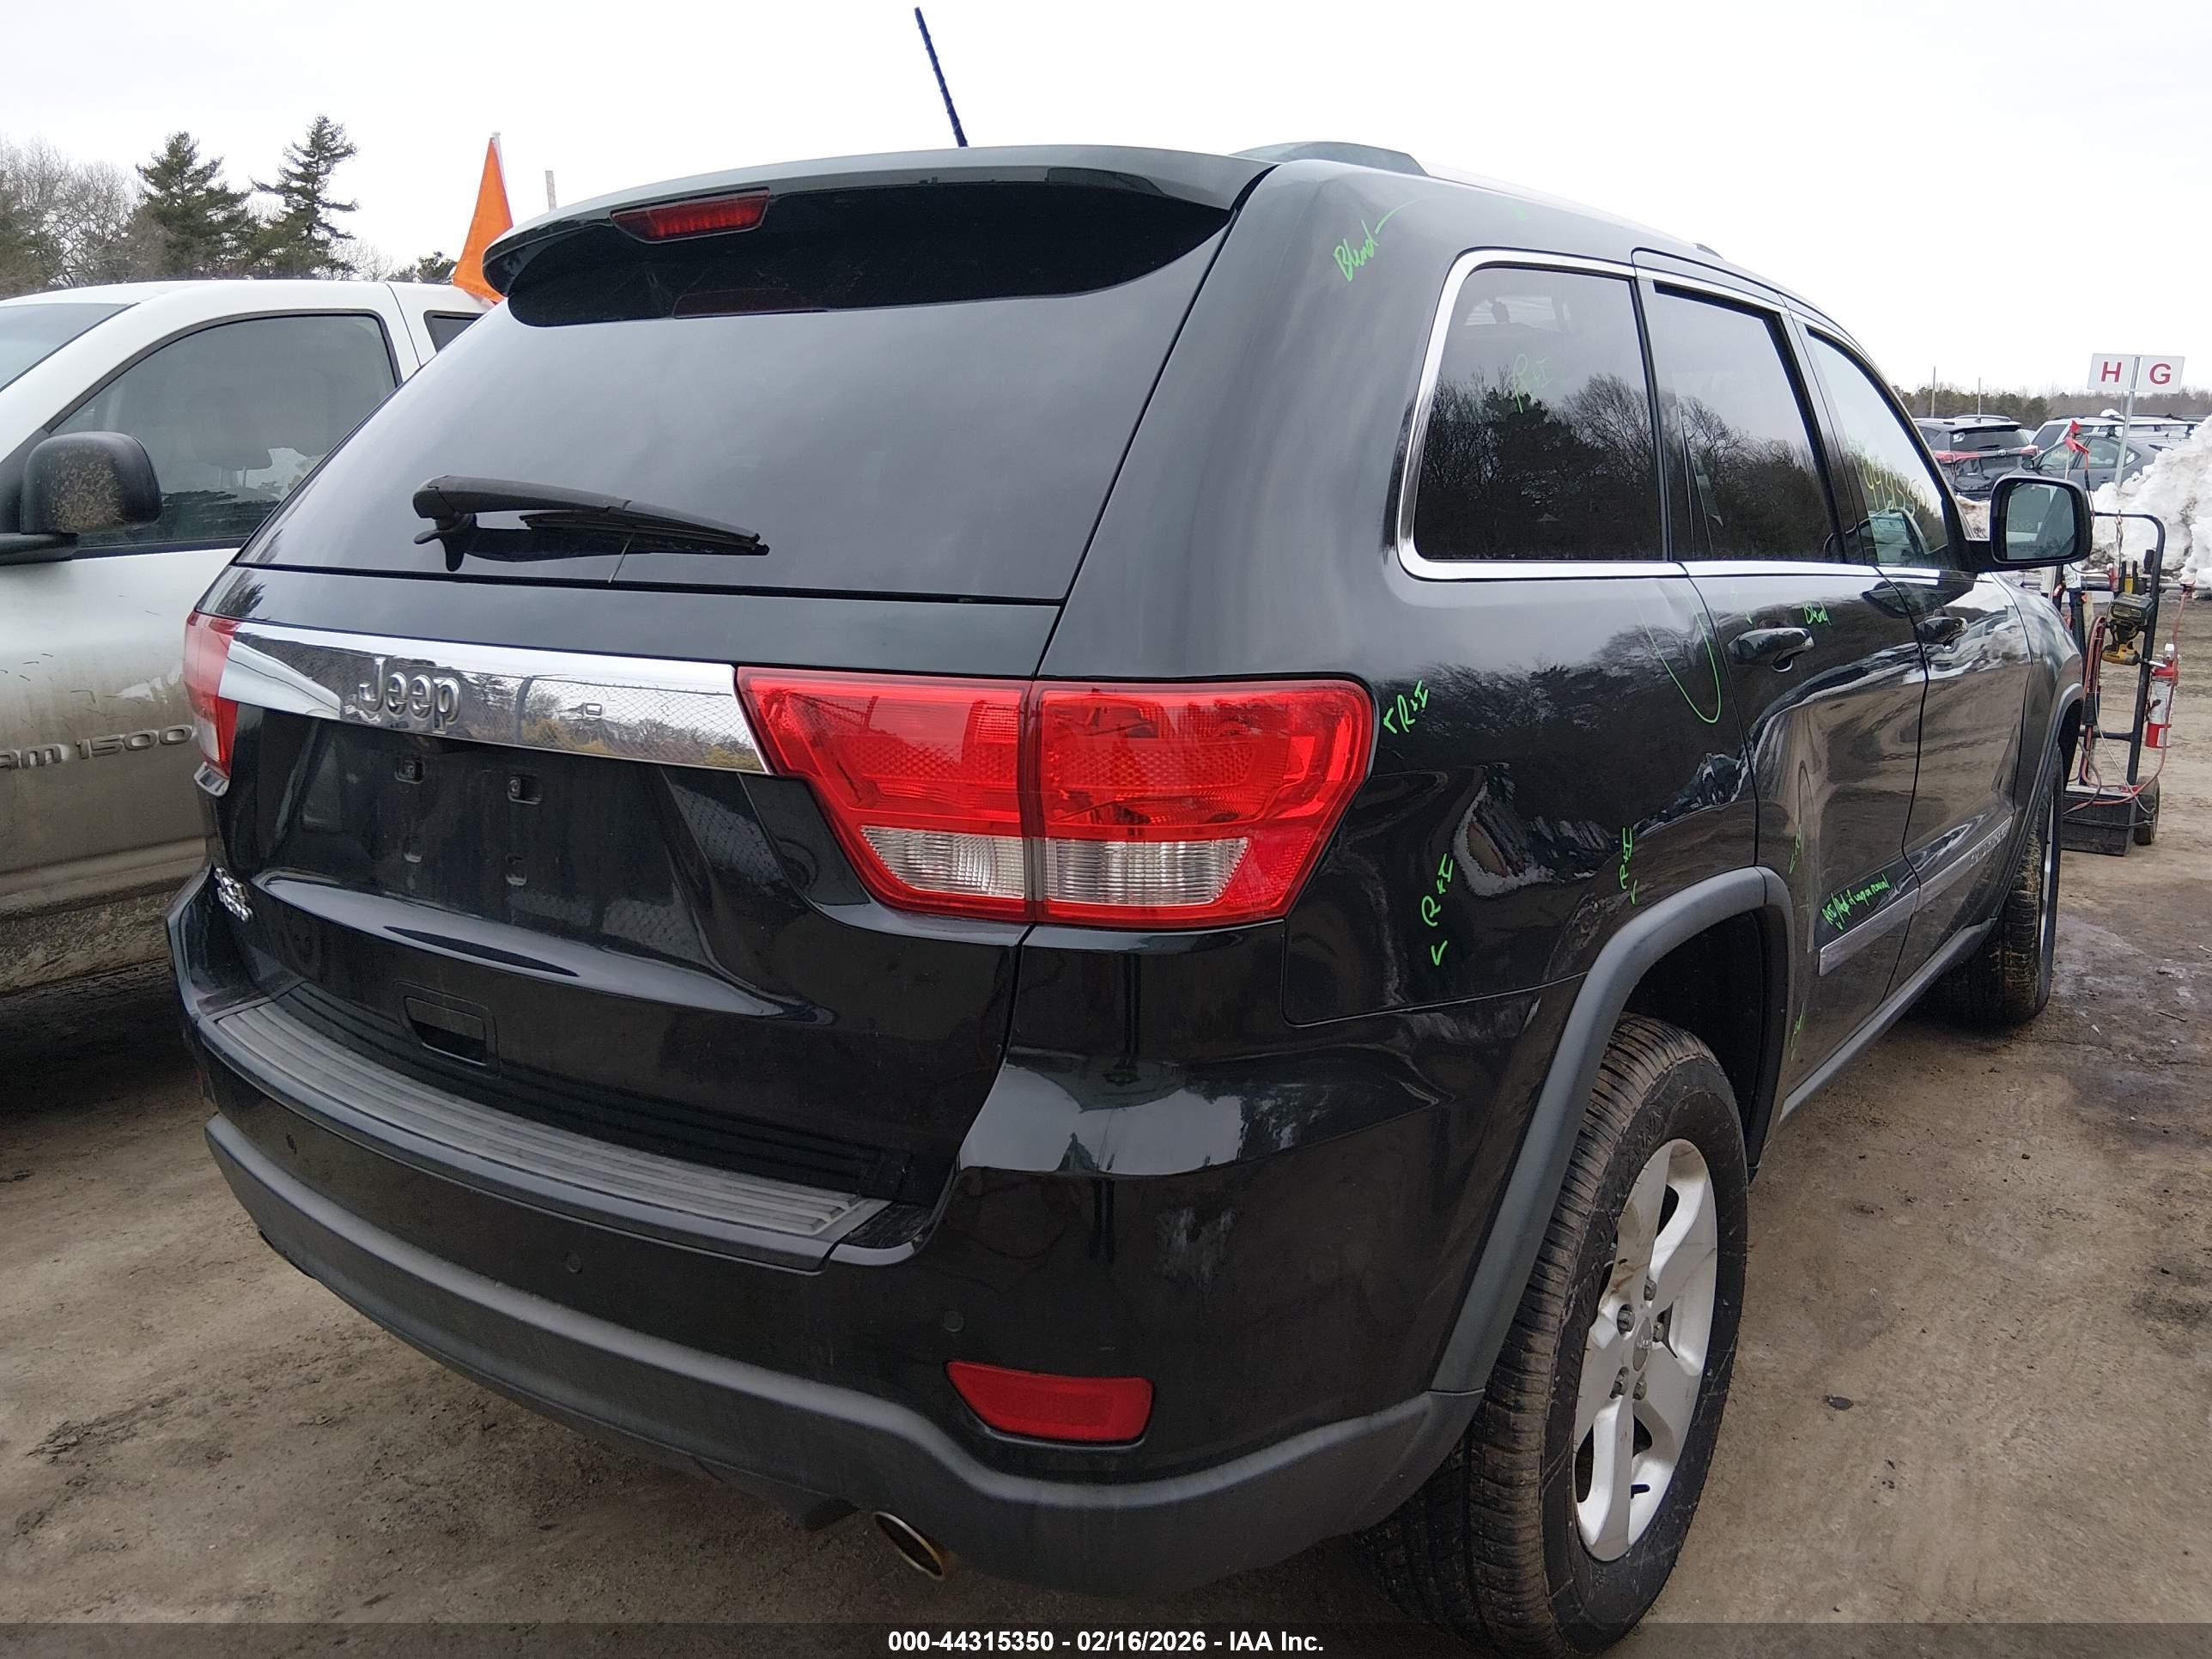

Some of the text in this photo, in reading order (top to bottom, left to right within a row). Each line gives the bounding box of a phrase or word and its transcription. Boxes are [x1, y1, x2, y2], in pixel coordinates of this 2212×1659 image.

[2100, 361, 2122, 383] H
[2148, 362, 2172, 386] G
[358, 656, 461, 735] Jeep
[76, 725, 194, 760] 1500
